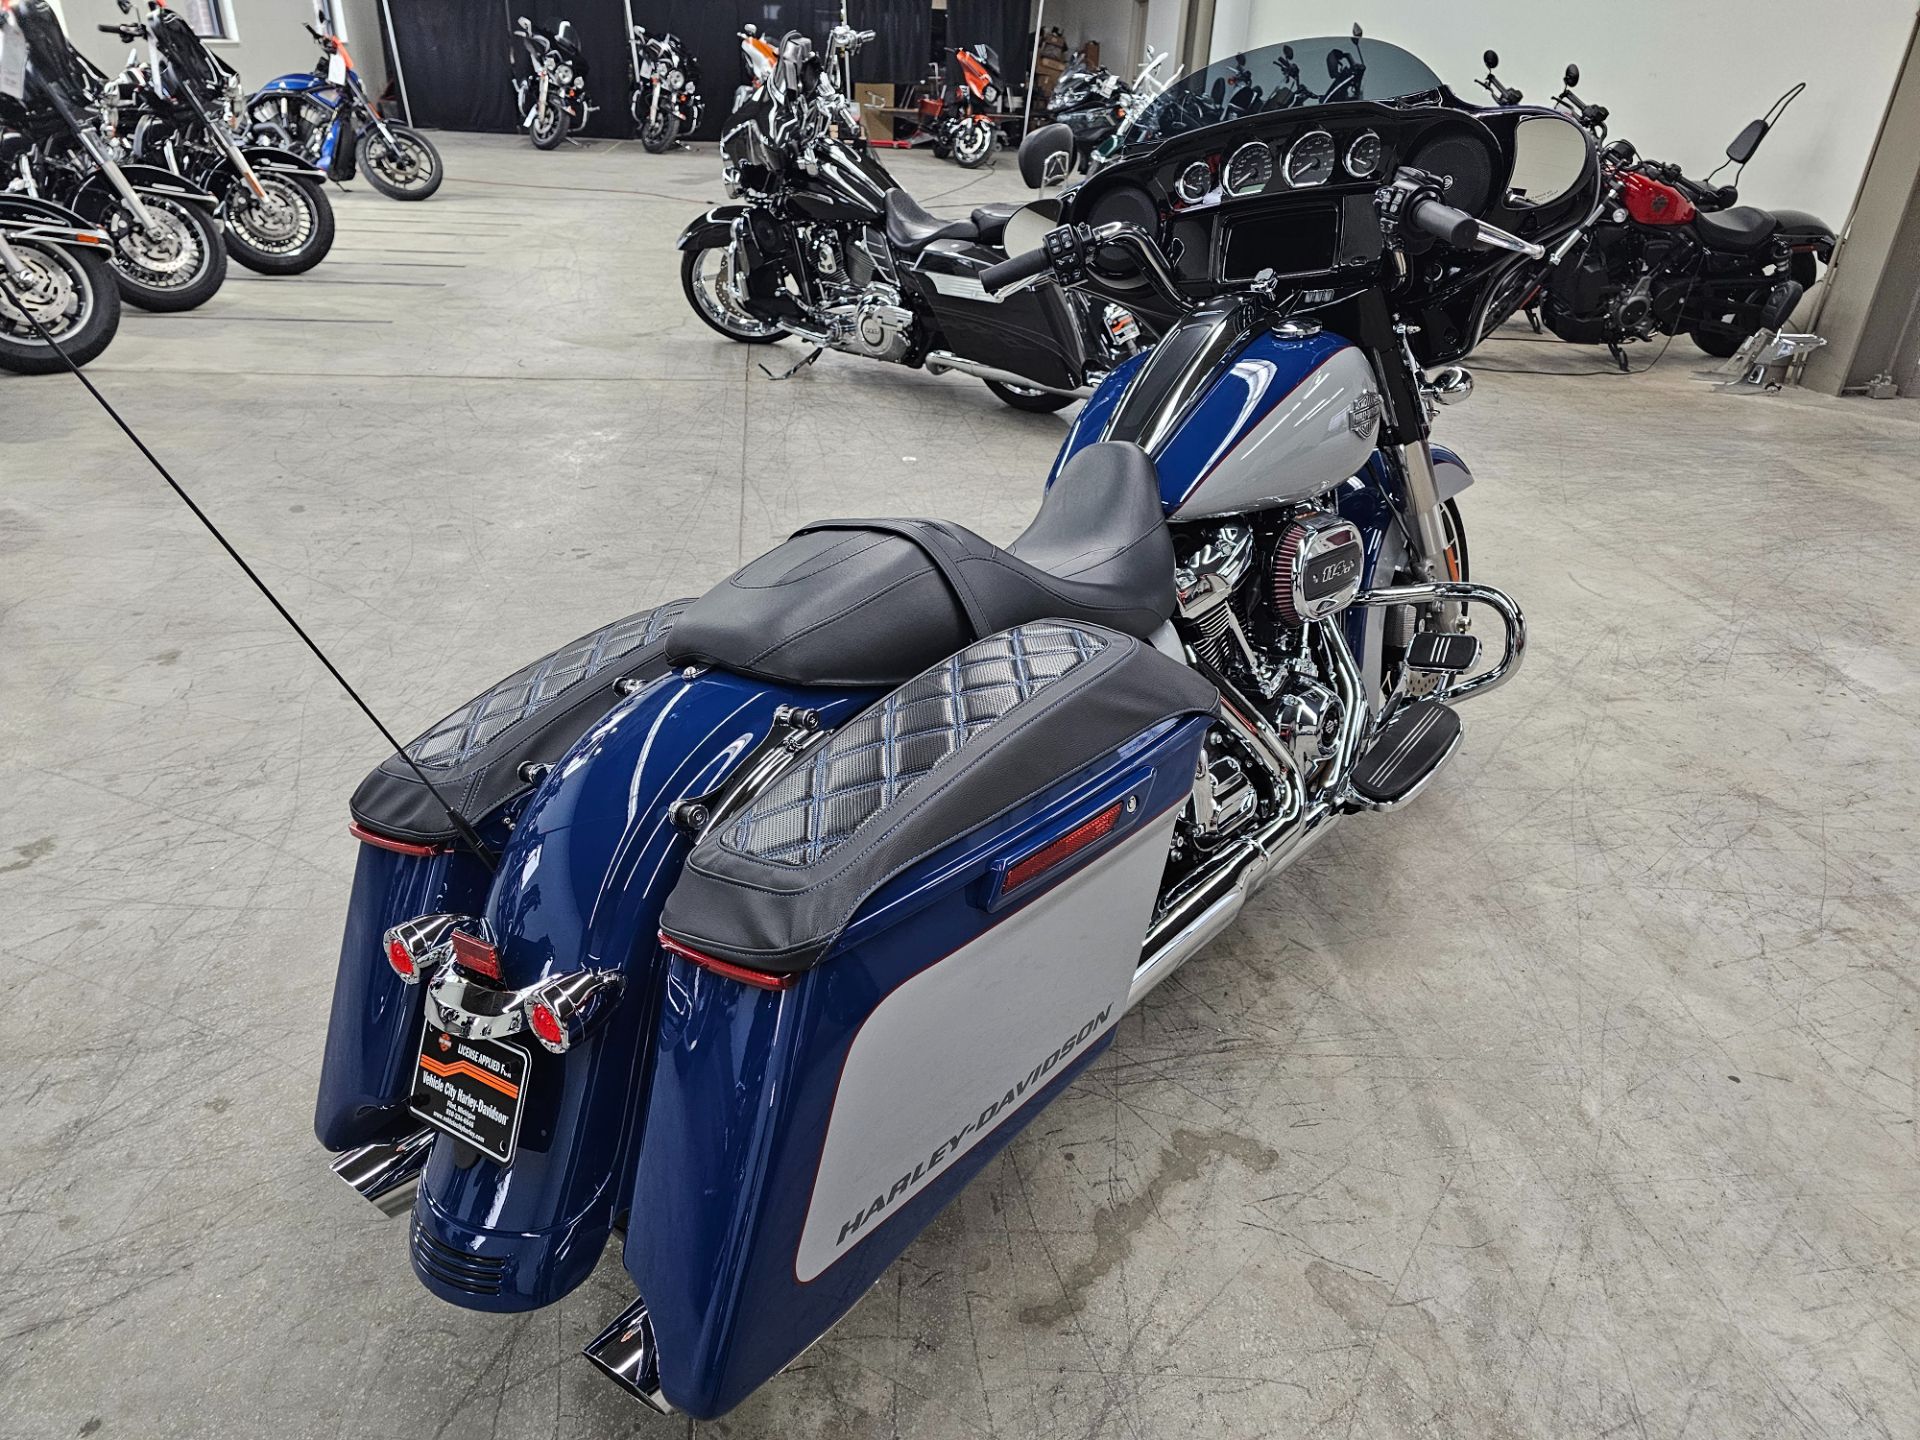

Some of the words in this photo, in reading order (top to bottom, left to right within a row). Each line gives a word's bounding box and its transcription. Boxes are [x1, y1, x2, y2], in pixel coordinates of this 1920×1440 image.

[1322, 560, 1345, 582] 114
[457, 1043, 480, 1062] LICENSE
[477, 1053, 501, 1073] APPLIED
[422, 1070, 444, 1092] Vehicle
[444, 1081, 457, 1100] City
[835, 1001, 1115, 1247] HARLEY-DAVIDSON
